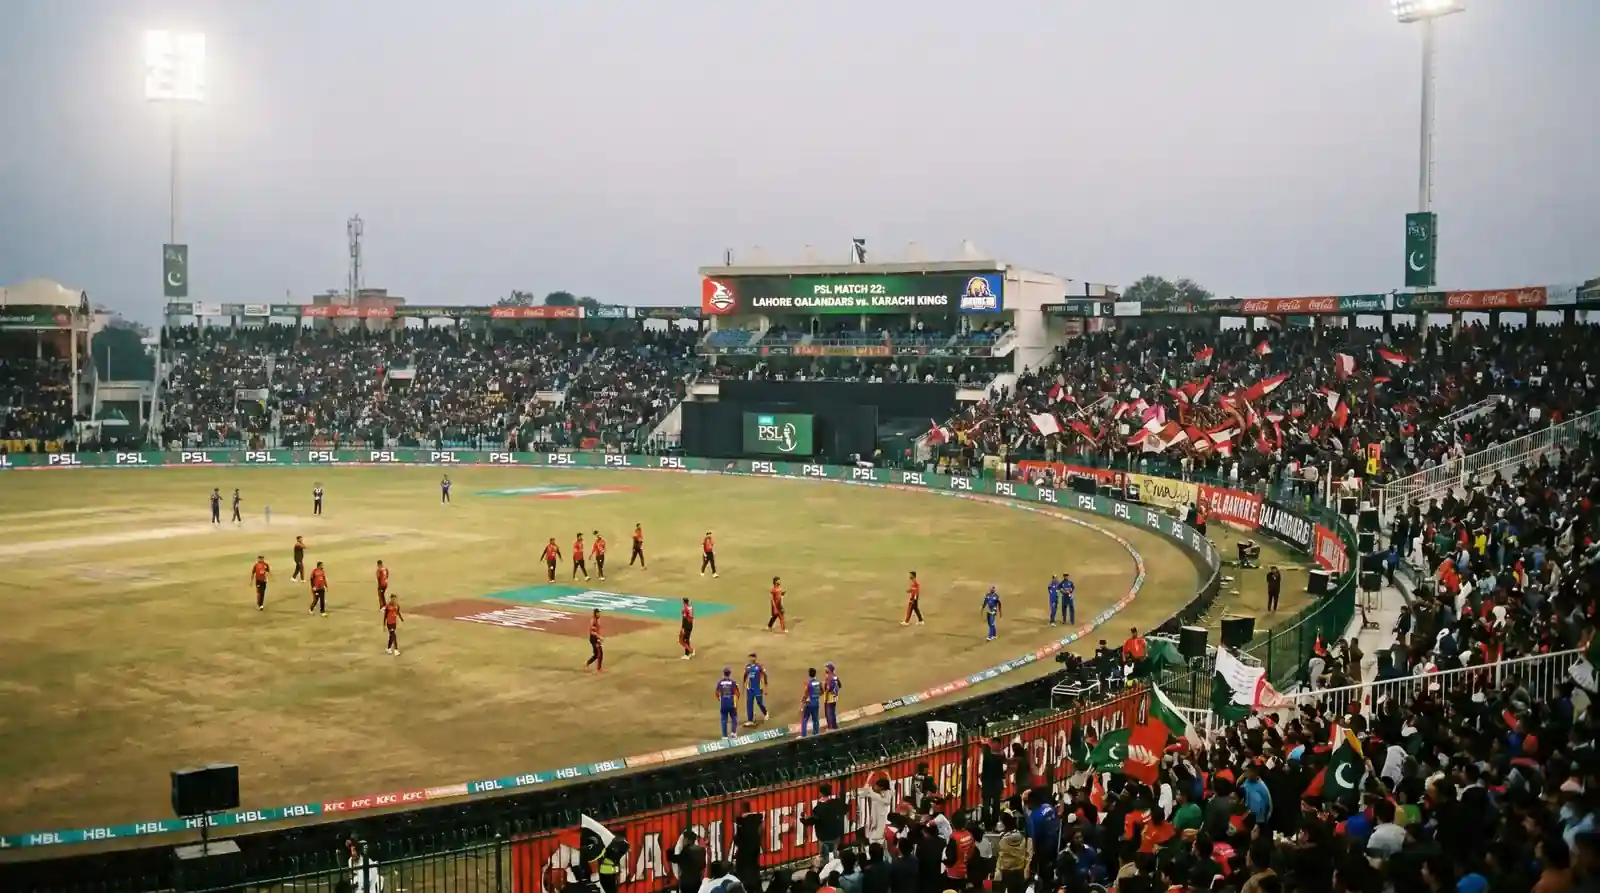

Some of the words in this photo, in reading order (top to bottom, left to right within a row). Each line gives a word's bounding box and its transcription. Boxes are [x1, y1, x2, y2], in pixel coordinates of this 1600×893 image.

[814, 285, 832, 294] PSL
[835, 285, 868, 294] MATCH
[870, 285, 886, 294] 22:
[753, 297, 792, 307] LAHORE
[856, 297, 869, 306] vs.
[872, 296, 915, 306] KARACHI
[917, 295, 948, 305] KINGS
[758, 425, 784, 439] PSL
[49, 454, 81, 465] PSL
[116, 453, 148, 464] PSL
[182, 452, 212, 463] PSL
[245, 451, 277, 461] PSL
[308, 451, 339, 461] PSL
[370, 451, 399, 461] PSL
[431, 451, 461, 462] PSL
[490, 452, 519, 463] PSL
[548, 453, 576, 464] PSL
[605, 454, 631, 465] PSL
[660, 456, 686, 468] PSL
[751, 461, 777, 473] PSL
[803, 464, 827, 477] PSL
[853, 467, 877, 480] PSL
[903, 471, 927, 485] PSL
[950, 477, 973, 490] PSL
[996, 482, 1016, 496] PSL
[1038, 488, 1057, 503] PSL
[1078, 495, 1096, 510] PSL
[1114, 503, 1131, 519] PSL
[1147, 511, 1160, 529] PSL
[1171, 521, 1184, 540] PSL
[594, 760, 620, 773] HBL
[516, 773, 543, 785] HBL
[556, 767, 582, 779] HBL
[475, 780, 502, 792] HBL
[376, 795, 397, 805] KFC
[402, 791, 423, 801] KFC
[324, 802, 345, 812] KFC
[352, 798, 371, 808] KFC
[235, 810, 267, 823] HBL
[283, 804, 314, 817] HBL
[135, 822, 168, 834] HBL
[31, 833, 64, 845] HBL
[82, 828, 116, 841] HBL
